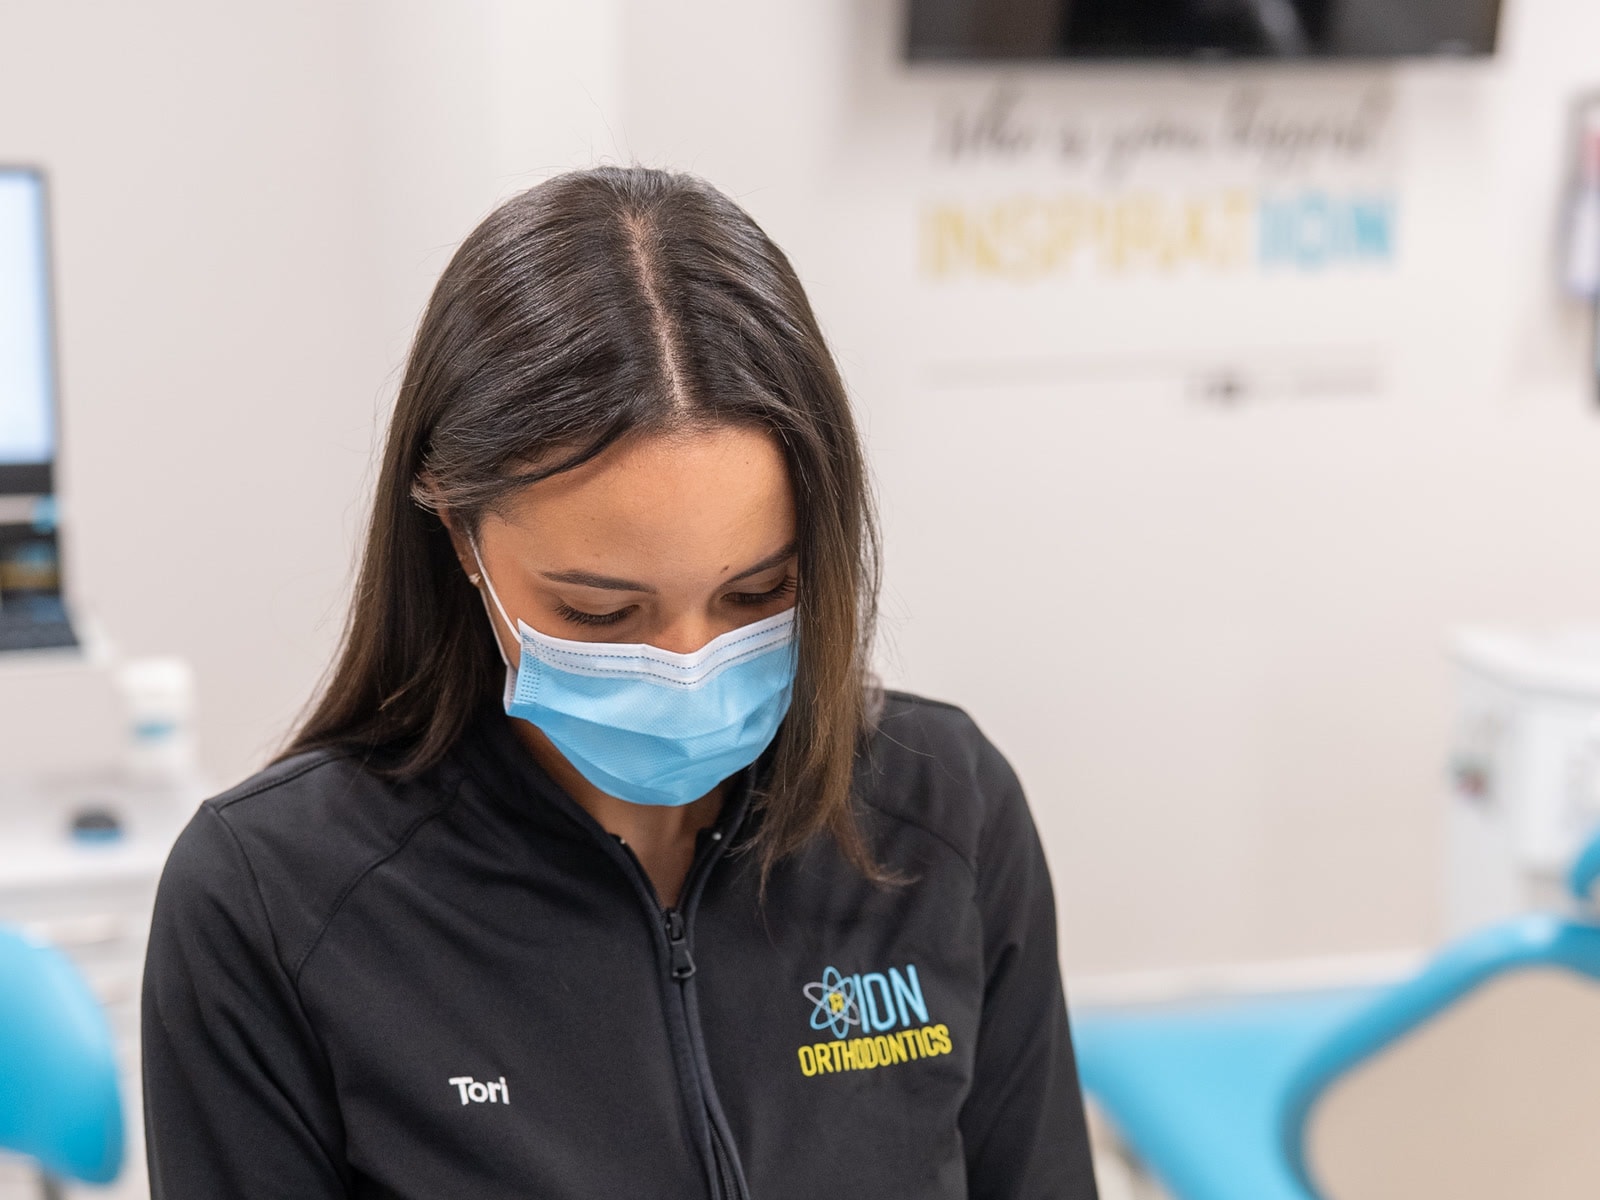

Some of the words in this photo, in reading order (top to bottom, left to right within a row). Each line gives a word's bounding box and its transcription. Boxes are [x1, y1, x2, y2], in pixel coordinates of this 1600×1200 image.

[853, 964, 929, 1034] ION
[798, 1023, 952, 1077] ORTHODONTICS
[448, 1076, 510, 1106] Tori
